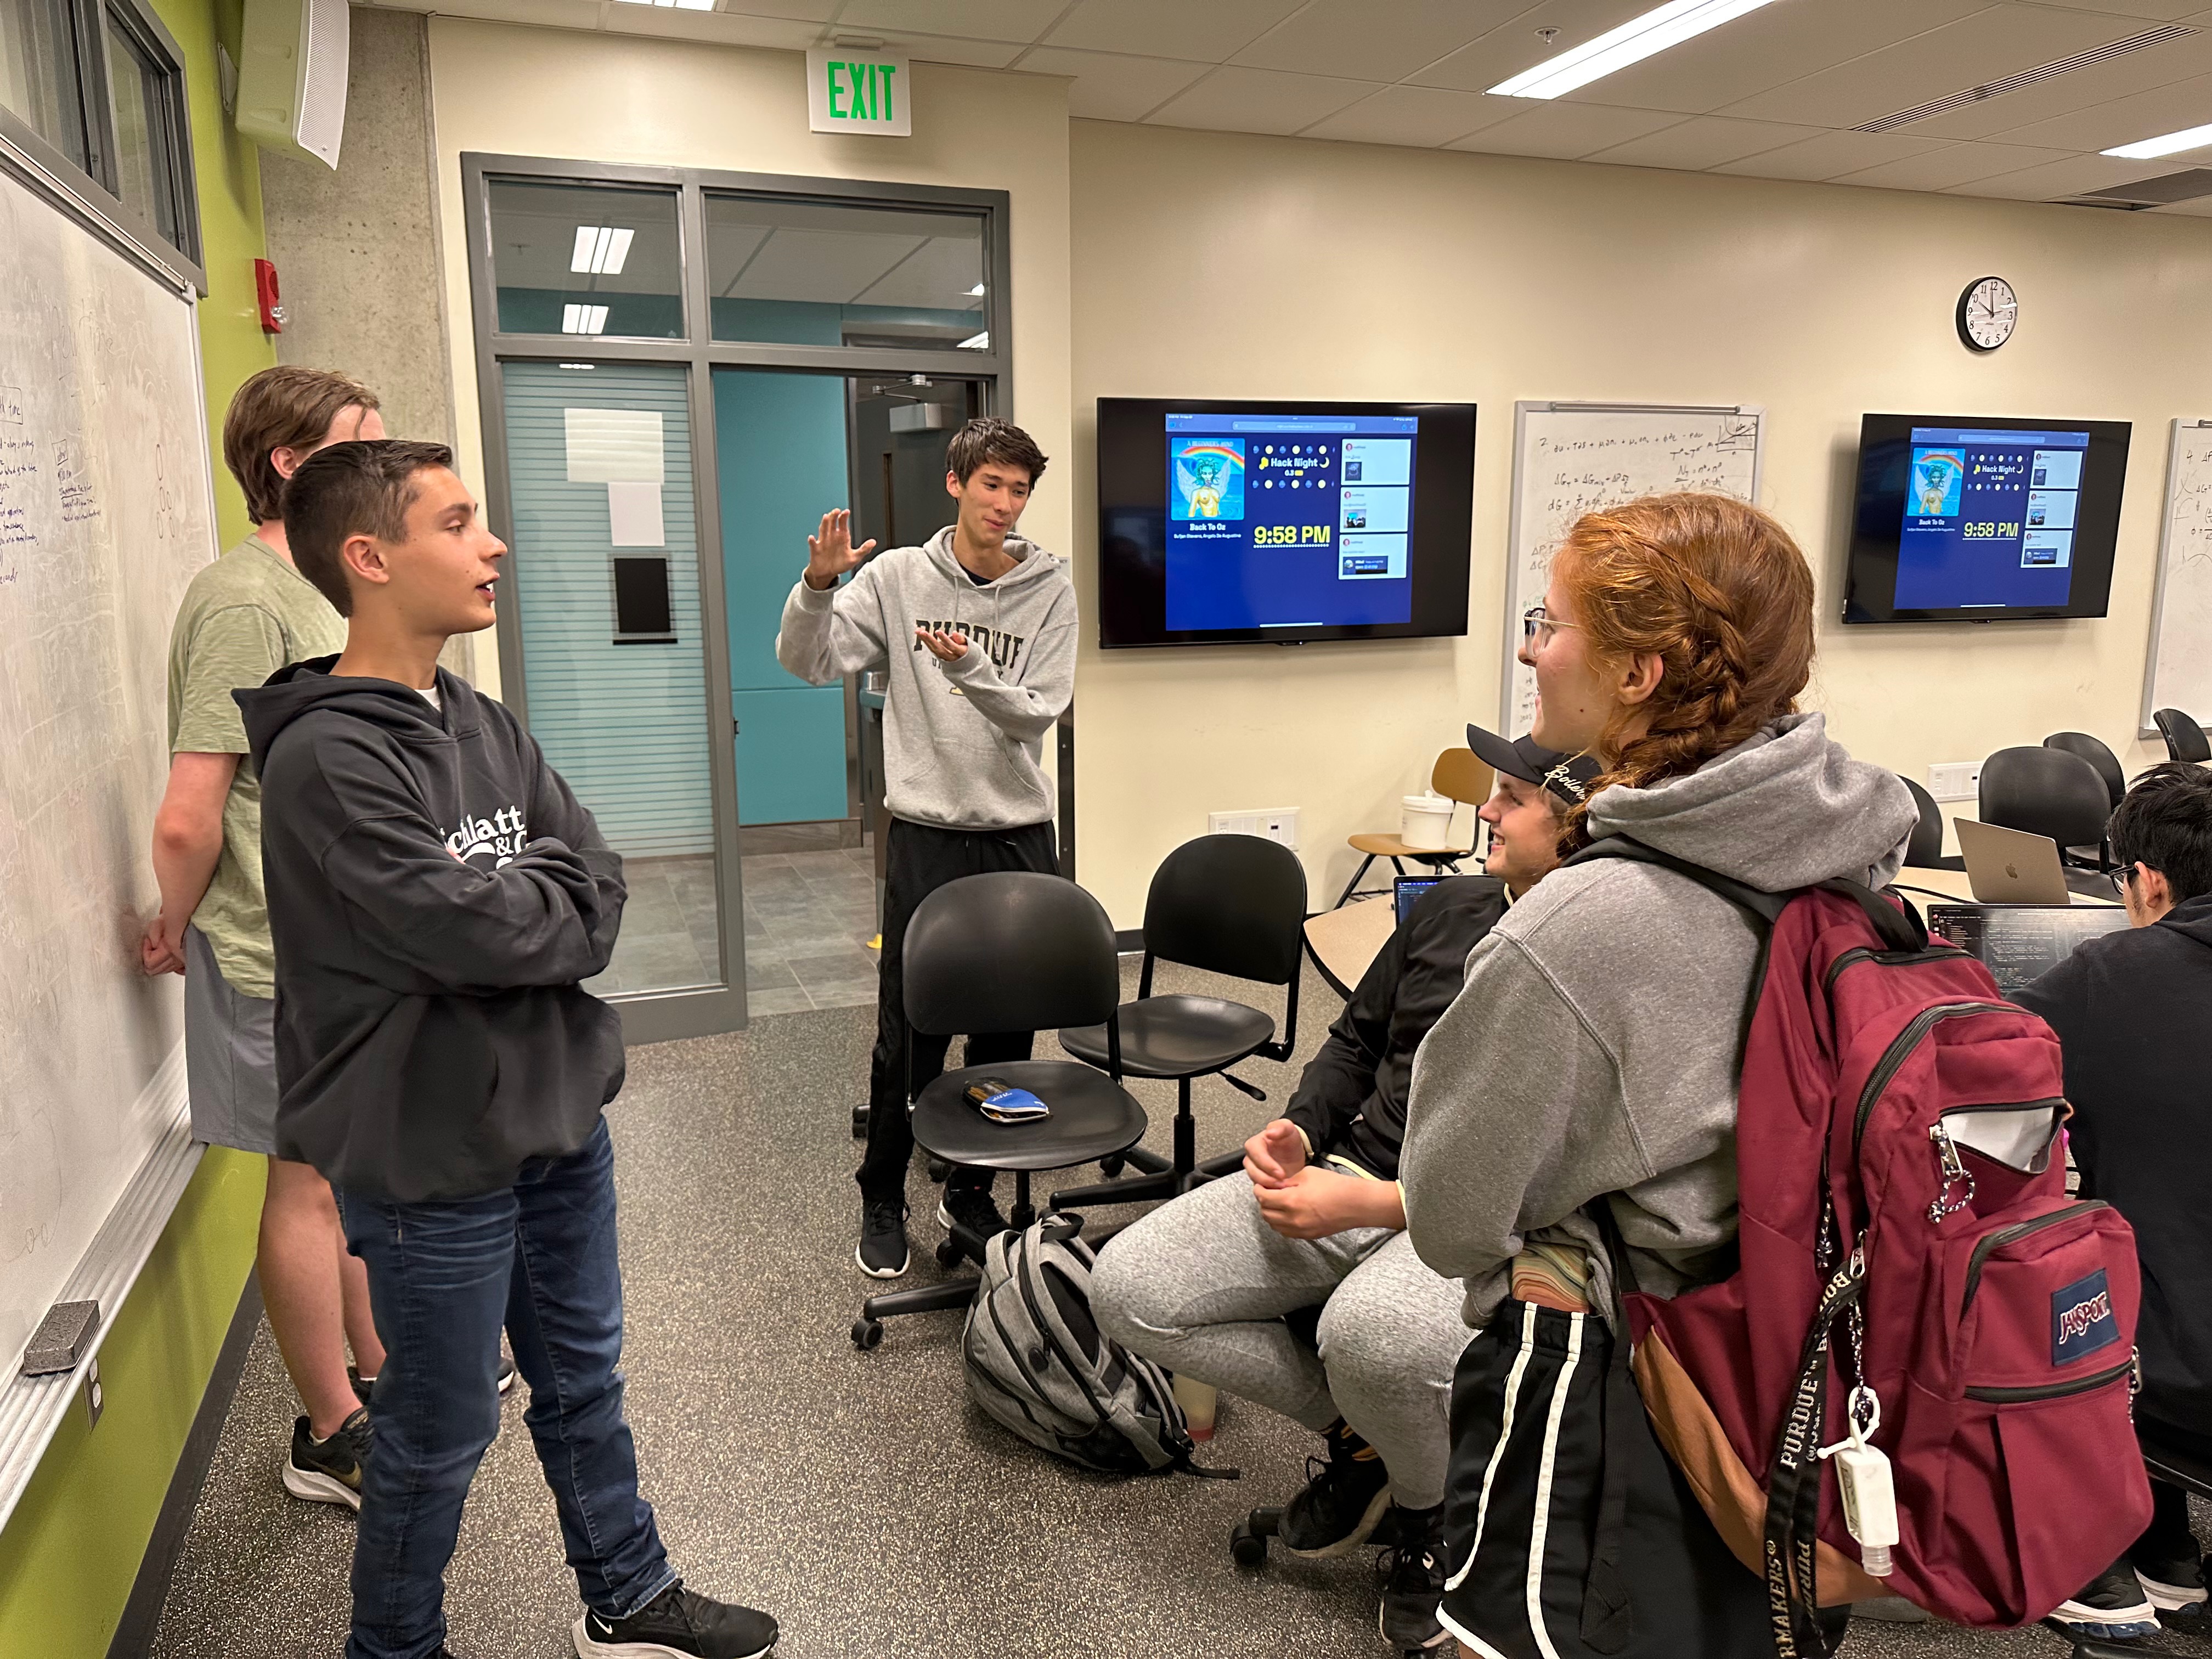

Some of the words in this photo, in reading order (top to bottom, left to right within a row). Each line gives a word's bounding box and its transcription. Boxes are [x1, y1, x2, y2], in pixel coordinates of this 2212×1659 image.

[827, 61, 896, 121] EXIT
[1980, 284, 1987, 294] 11
[1990, 281, 1997, 290] 12
[2001, 287, 2004, 296] 1
[1967, 307, 1973, 316] 9
[2008, 311, 2012, 320] 3
[1969, 320, 1974, 329] 8
[2004, 324, 2008, 332] 4
[1976, 331, 1982, 341] 7
[1985, 336, 1990, 345] 6
[1995, 334, 2000, 342] 5
[1271, 458, 1293, 467] Hack
[1294, 458, 1318, 469] Night
[1998, 465, 2016, 475] Night
[1189, 523, 1207, 531] Back
[1963, 522, 1995, 537] 9:58
[1997, 522, 2019, 537] PM
[1254, 525, 1297, 544] 9:58
[1301, 525, 1330, 543] PM
[440, 805, 525, 854] chlatt
